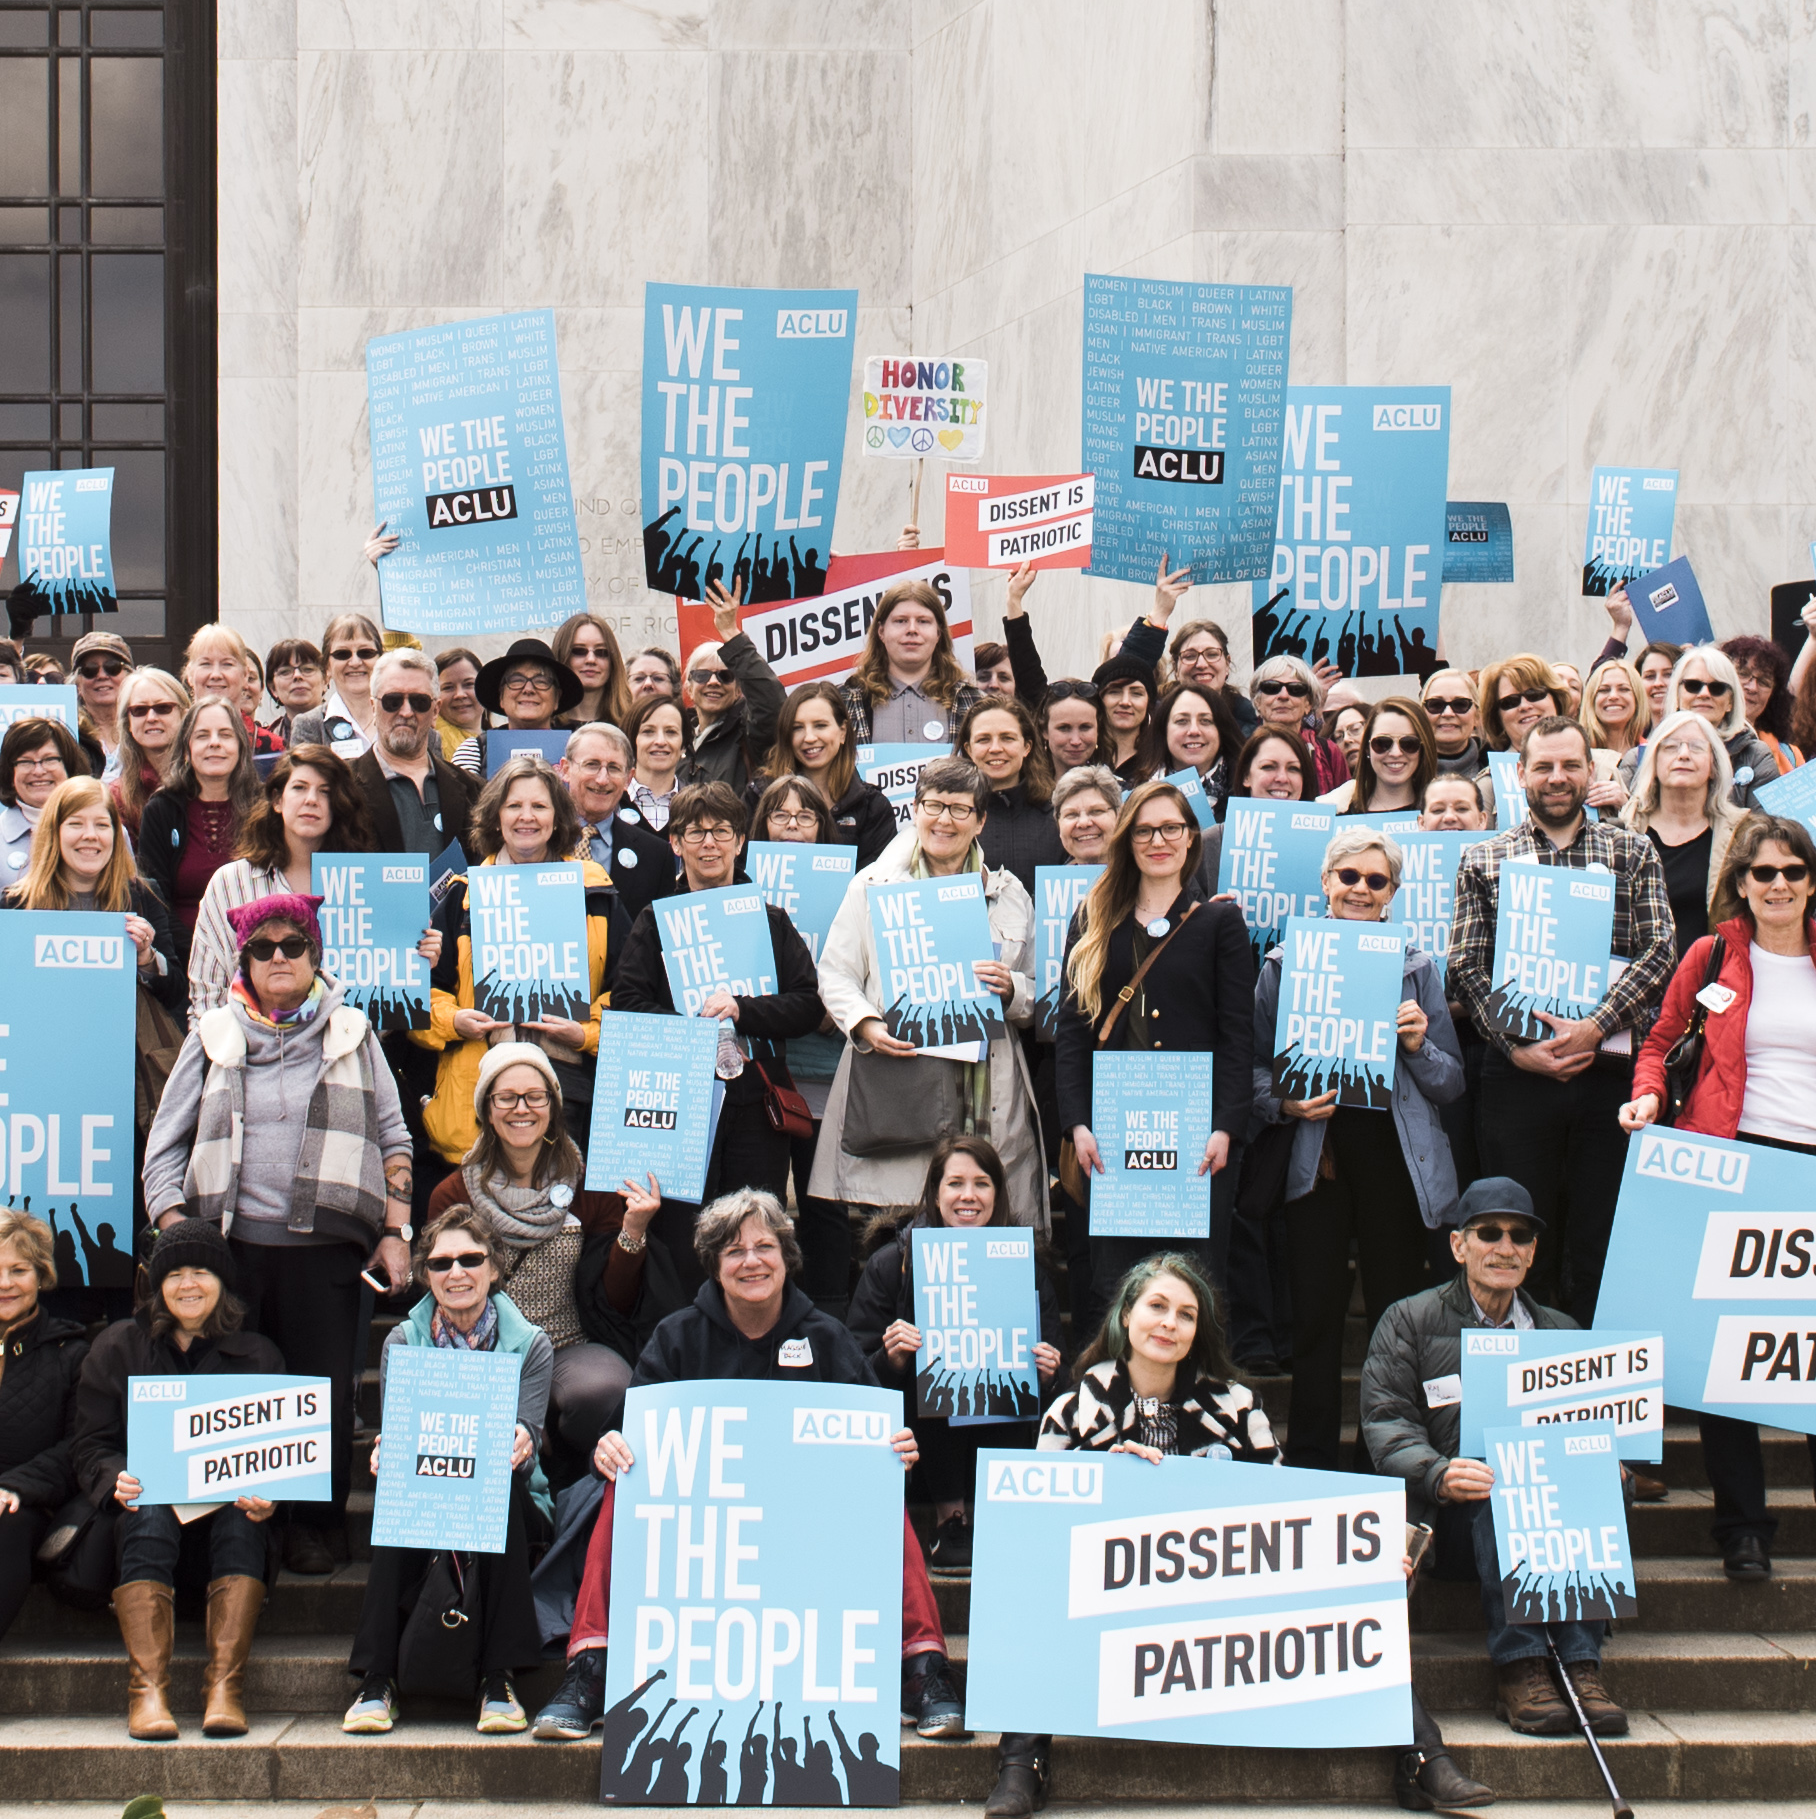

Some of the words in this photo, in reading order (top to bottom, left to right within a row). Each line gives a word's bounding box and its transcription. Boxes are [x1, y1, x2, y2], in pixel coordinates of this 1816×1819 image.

[1089, 279, 1127, 291] WOMEN
[1142, 284, 1183, 296] MUSLIM
[1198, 288, 1234, 299] QUEER
[1250, 290, 1286, 301] LATINX
[782, 314, 842, 334] ACLU
[663, 304, 743, 380] WE
[882, 359, 965, 393] HONOR
[864, 392, 983, 424] DIVERSITY
[1137, 377, 1174, 410] WE
[1182, 381, 1228, 413] THE
[658, 381, 753, 457] THE
[1136, 412, 1226, 448] PEOPLE
[1138, 450, 1219, 480] ACLU
[30, 481, 64, 512] WE
[78, 480, 107, 490] ACLU
[659, 457, 828, 533] PEOPLE
[953, 480, 985, 491] ACLU
[991, 491, 1060, 522] DISSENT
[1069, 486, 1083, 505] IS
[1448, 514, 1463, 522] WE
[1467, 515, 1486, 523] THE
[25, 512, 66, 545] THE
[1001, 522, 1081, 556] PATRIOTIC
[1449, 523, 1487, 532] PEOPLE
[1453, 532, 1486, 541] ACLU
[25, 545, 105, 579] PEOPLE
[41, 941, 117, 964] ACLU
[1644, 1144, 1741, 1185] ACLU
[137, 1385, 182, 1398] ACLU
[190, 1398, 285, 1438] DISSENT
[297, 1393, 316, 1417] IS
[800, 1414, 883, 1440] ACLU
[205, 1441, 316, 1483] PATRIOTIC
[642, 1407, 747, 1498] WE
[995, 1467, 1095, 1497] ACLU
[635, 1504, 763, 1600] THE
[1104, 1518, 1311, 1590] DISSENT
[1337, 1511, 1380, 1565] IS
[633, 1606, 879, 1702] PEOPLE
[1134, 1619, 1382, 1697] PATRIOTIC
